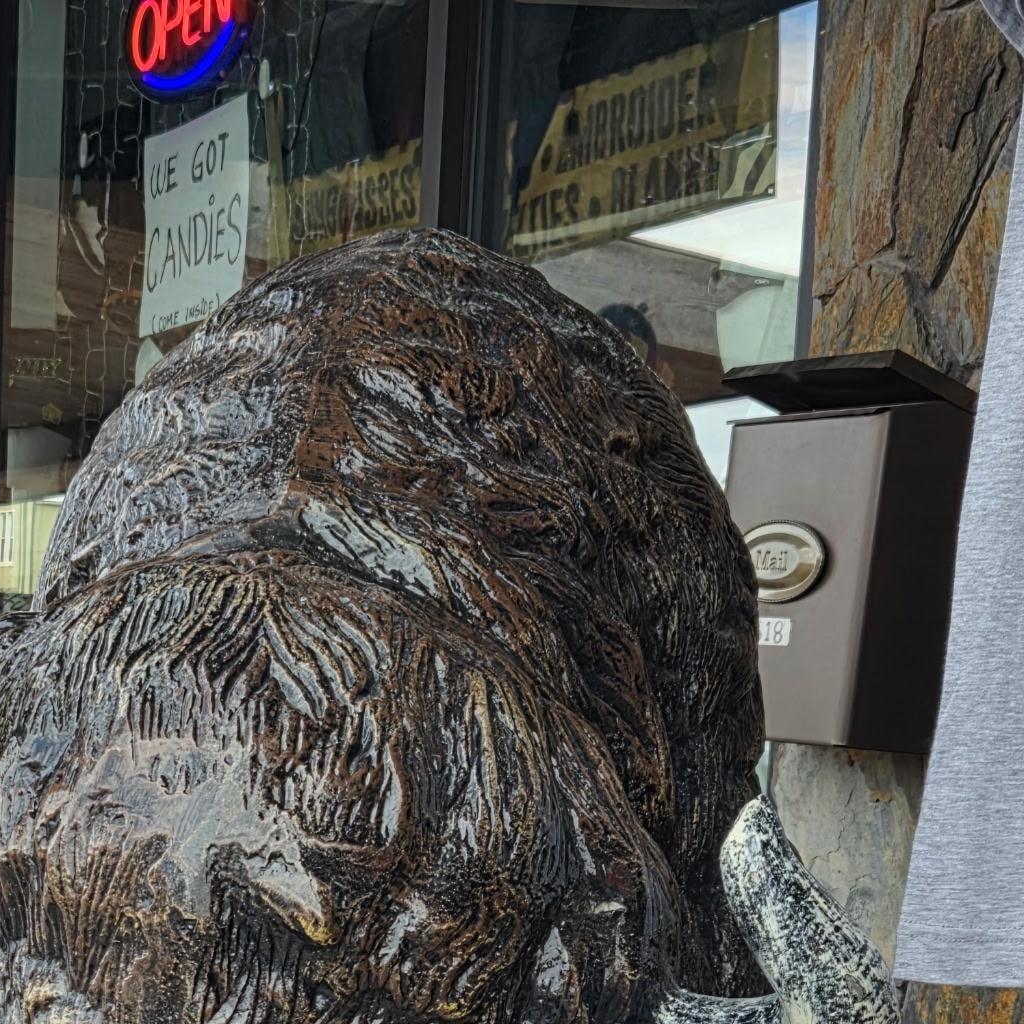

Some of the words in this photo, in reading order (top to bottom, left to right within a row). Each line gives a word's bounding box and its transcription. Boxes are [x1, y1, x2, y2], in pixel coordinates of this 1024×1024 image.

[132, 0, 231, 72] OPEN
[150, 153, 178, 200] WE
[192, 132, 229, 183] GOT
[755, 550, 788, 572] Mail
[759, 619, 784, 645] 18
